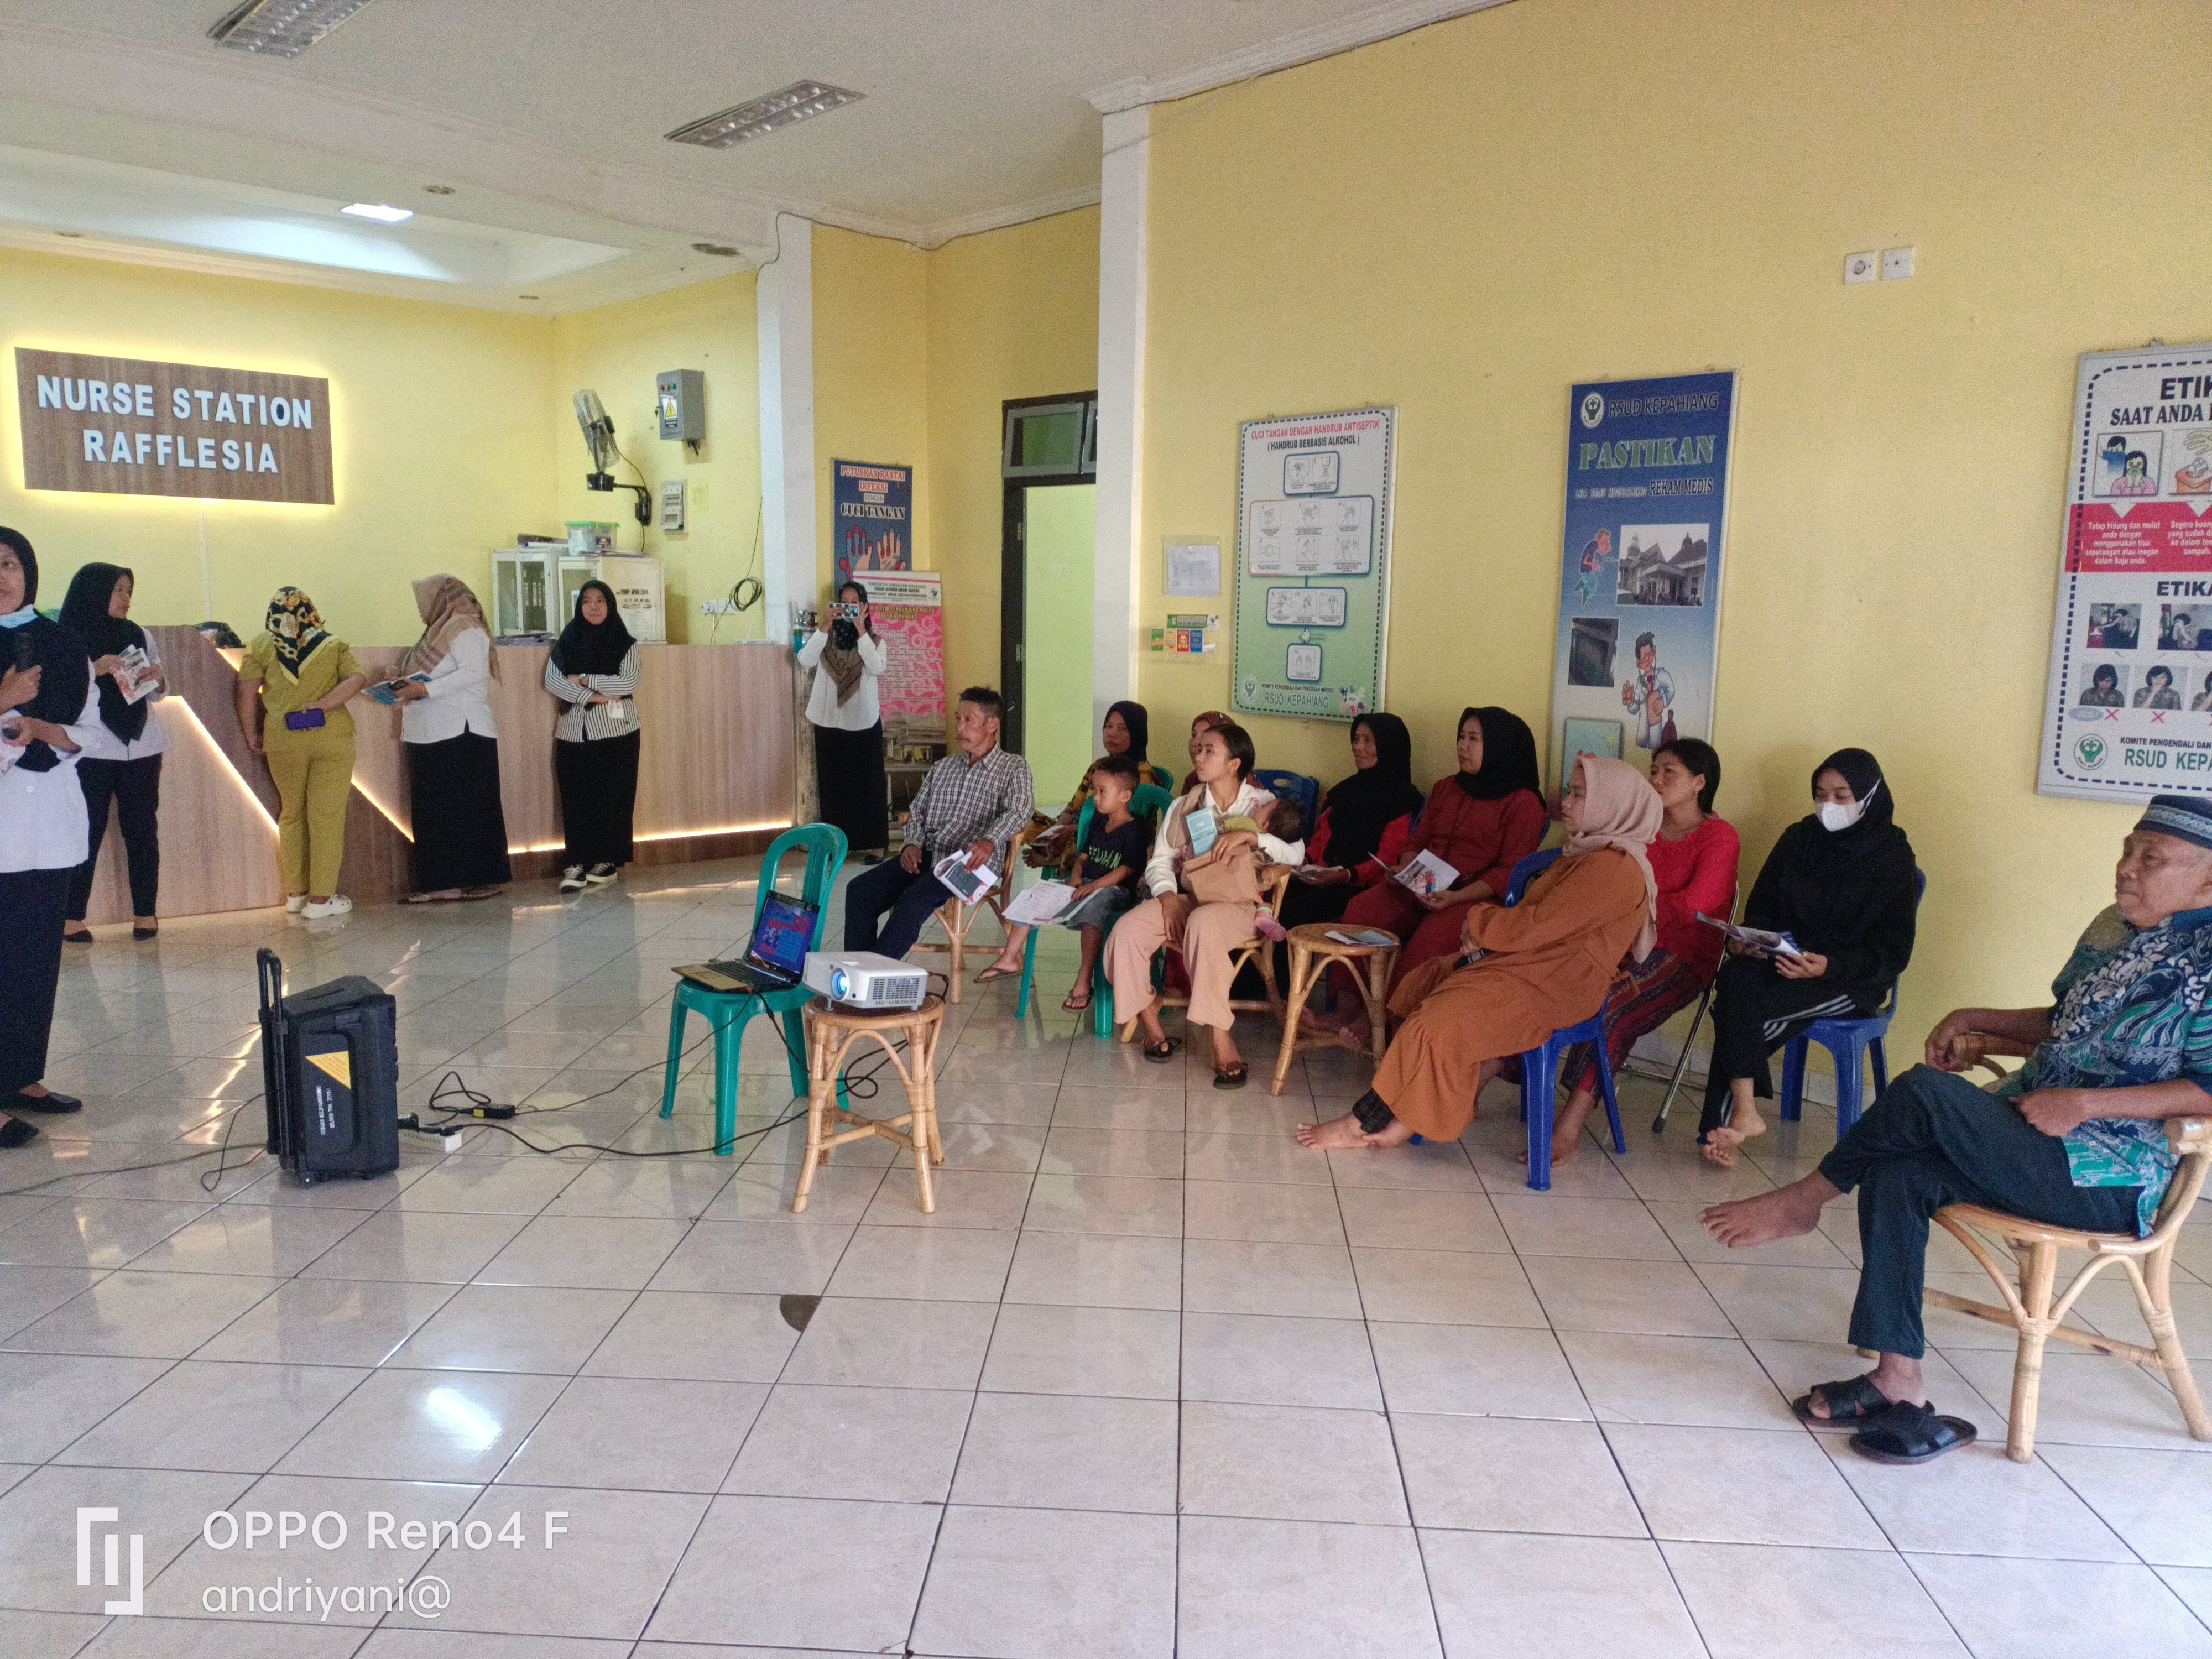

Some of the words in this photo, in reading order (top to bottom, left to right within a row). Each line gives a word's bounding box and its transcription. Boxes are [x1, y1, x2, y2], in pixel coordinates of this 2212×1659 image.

[37, 374, 154, 417] NURSE
[173, 388, 312, 429] STATION
[1609, 399, 1642, 417] RSUD
[1644, 392, 1718, 414] KEPAHIANG
[2110, 406, 2153, 426] SAAT
[2156, 404, 2203, 424] ANDA
[1251, 430, 1264, 440] CUCI
[1266, 427, 1288, 439] TANGAN
[1290, 426, 1313, 436] DENGAN
[1314, 423, 1342, 434] HANDRUB
[1343, 419, 1380, 431] ANTISEPTIK
[1299, 437, 1327, 448] BERBASIS
[83, 429, 278, 473] RAFFLESIA
[1579, 435, 1717, 471] PASTIKAN
[841, 465, 878, 479] PUTUSKAN
[879, 470, 906, 482] RANTAI
[859, 481, 888, 493] INFEKSI
[1650, 479, 1681, 495] REKAM
[1684, 478, 1713, 494] MEDIS
[864, 494, 884, 502] DENGAN
[841, 503, 864, 517] CUCI
[866, 505, 905, 519] TANGAN
[2107, 522, 2127, 530] hidung
[2171, 520, 2193, 529] Segera
[2119, 530, 2142, 539] dengan
[2168, 531, 2183, 539] yang
[2184, 547, 2211, 556] sampah.
[2115, 557, 2128, 566] baju
[1265, 692, 1284, 705] RSUD
[1287, 694, 1329, 708] KEPAHIANG
[2120, 737, 2147, 745] KOMITE
[2149, 738, 2194, 748] PENGENDALI
[2124, 748, 2167, 768] RSUD
